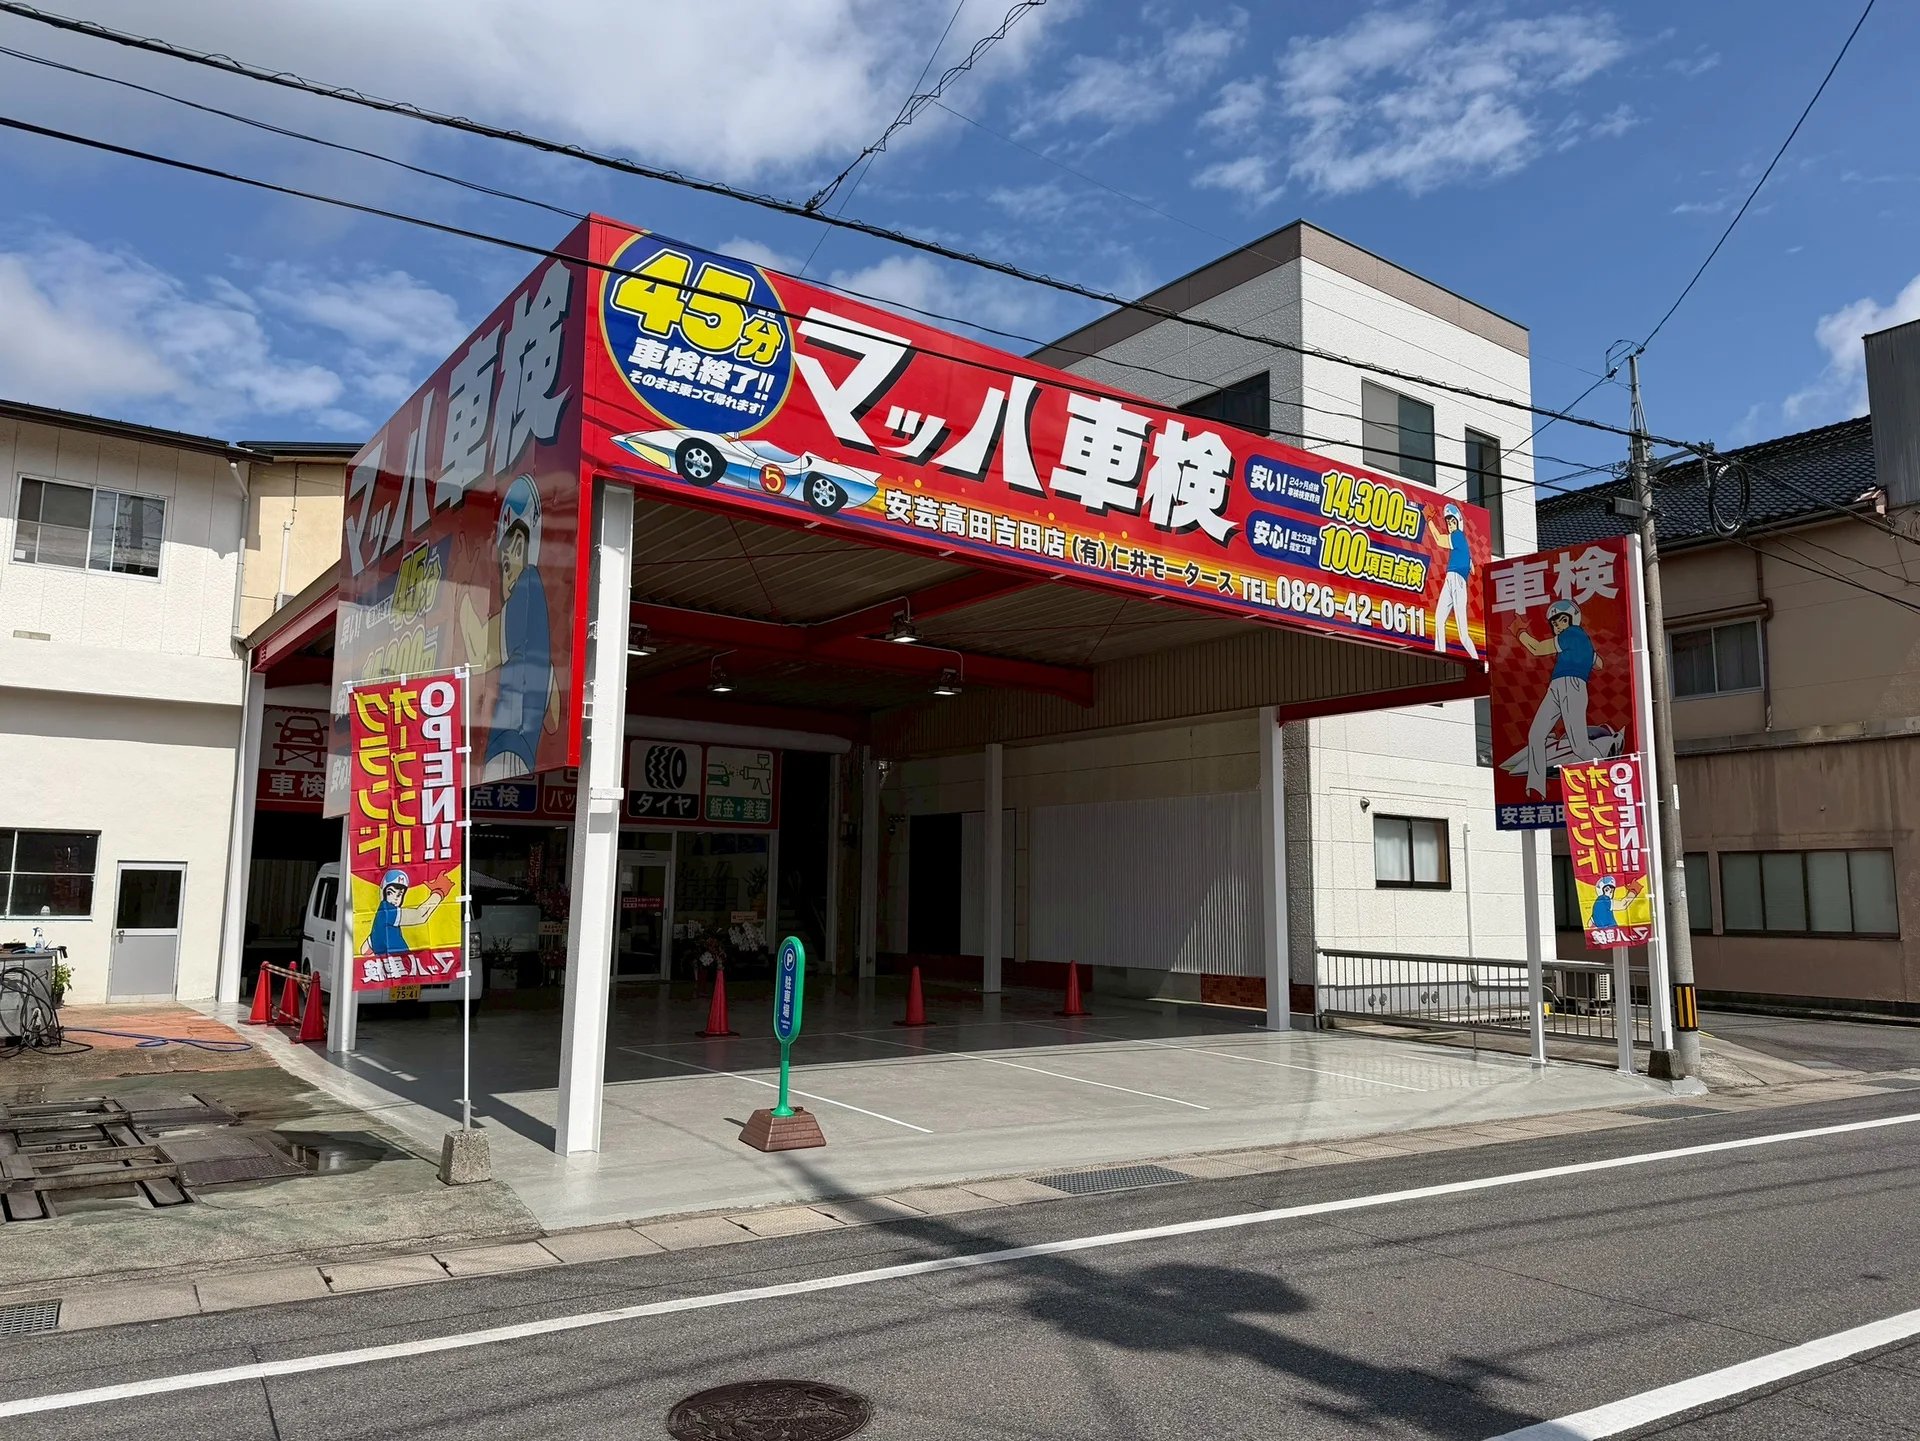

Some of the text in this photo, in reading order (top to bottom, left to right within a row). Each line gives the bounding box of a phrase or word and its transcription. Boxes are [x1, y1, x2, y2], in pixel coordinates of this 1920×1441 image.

[611, 248, 784, 365] 45分
[628, 337, 775, 400] 車検終了!!
[629, 371, 765, 416] そのまま乗って帰れます!
[346, 260, 572, 578] マッハ車検
[791, 307, 1240, 545] マッハ車検
[1250, 465, 1288, 495] 安い!
[1321, 470, 1421, 537] 14,300円
[885, 490, 1066, 559] 安芸高田吉田店
[1071, 535, 1235, 594] (有)仁井モータース
[1253, 520, 1289, 549] 安心!
[1320, 525, 1426, 592] 100項目点検
[389, 540, 442, 632] 45分
[1491, 546, 1619, 616] 車検
[269, 772, 325, 798] 車検
[471, 785, 520, 809] 点検
[637, 793, 691, 815] タイヤ
